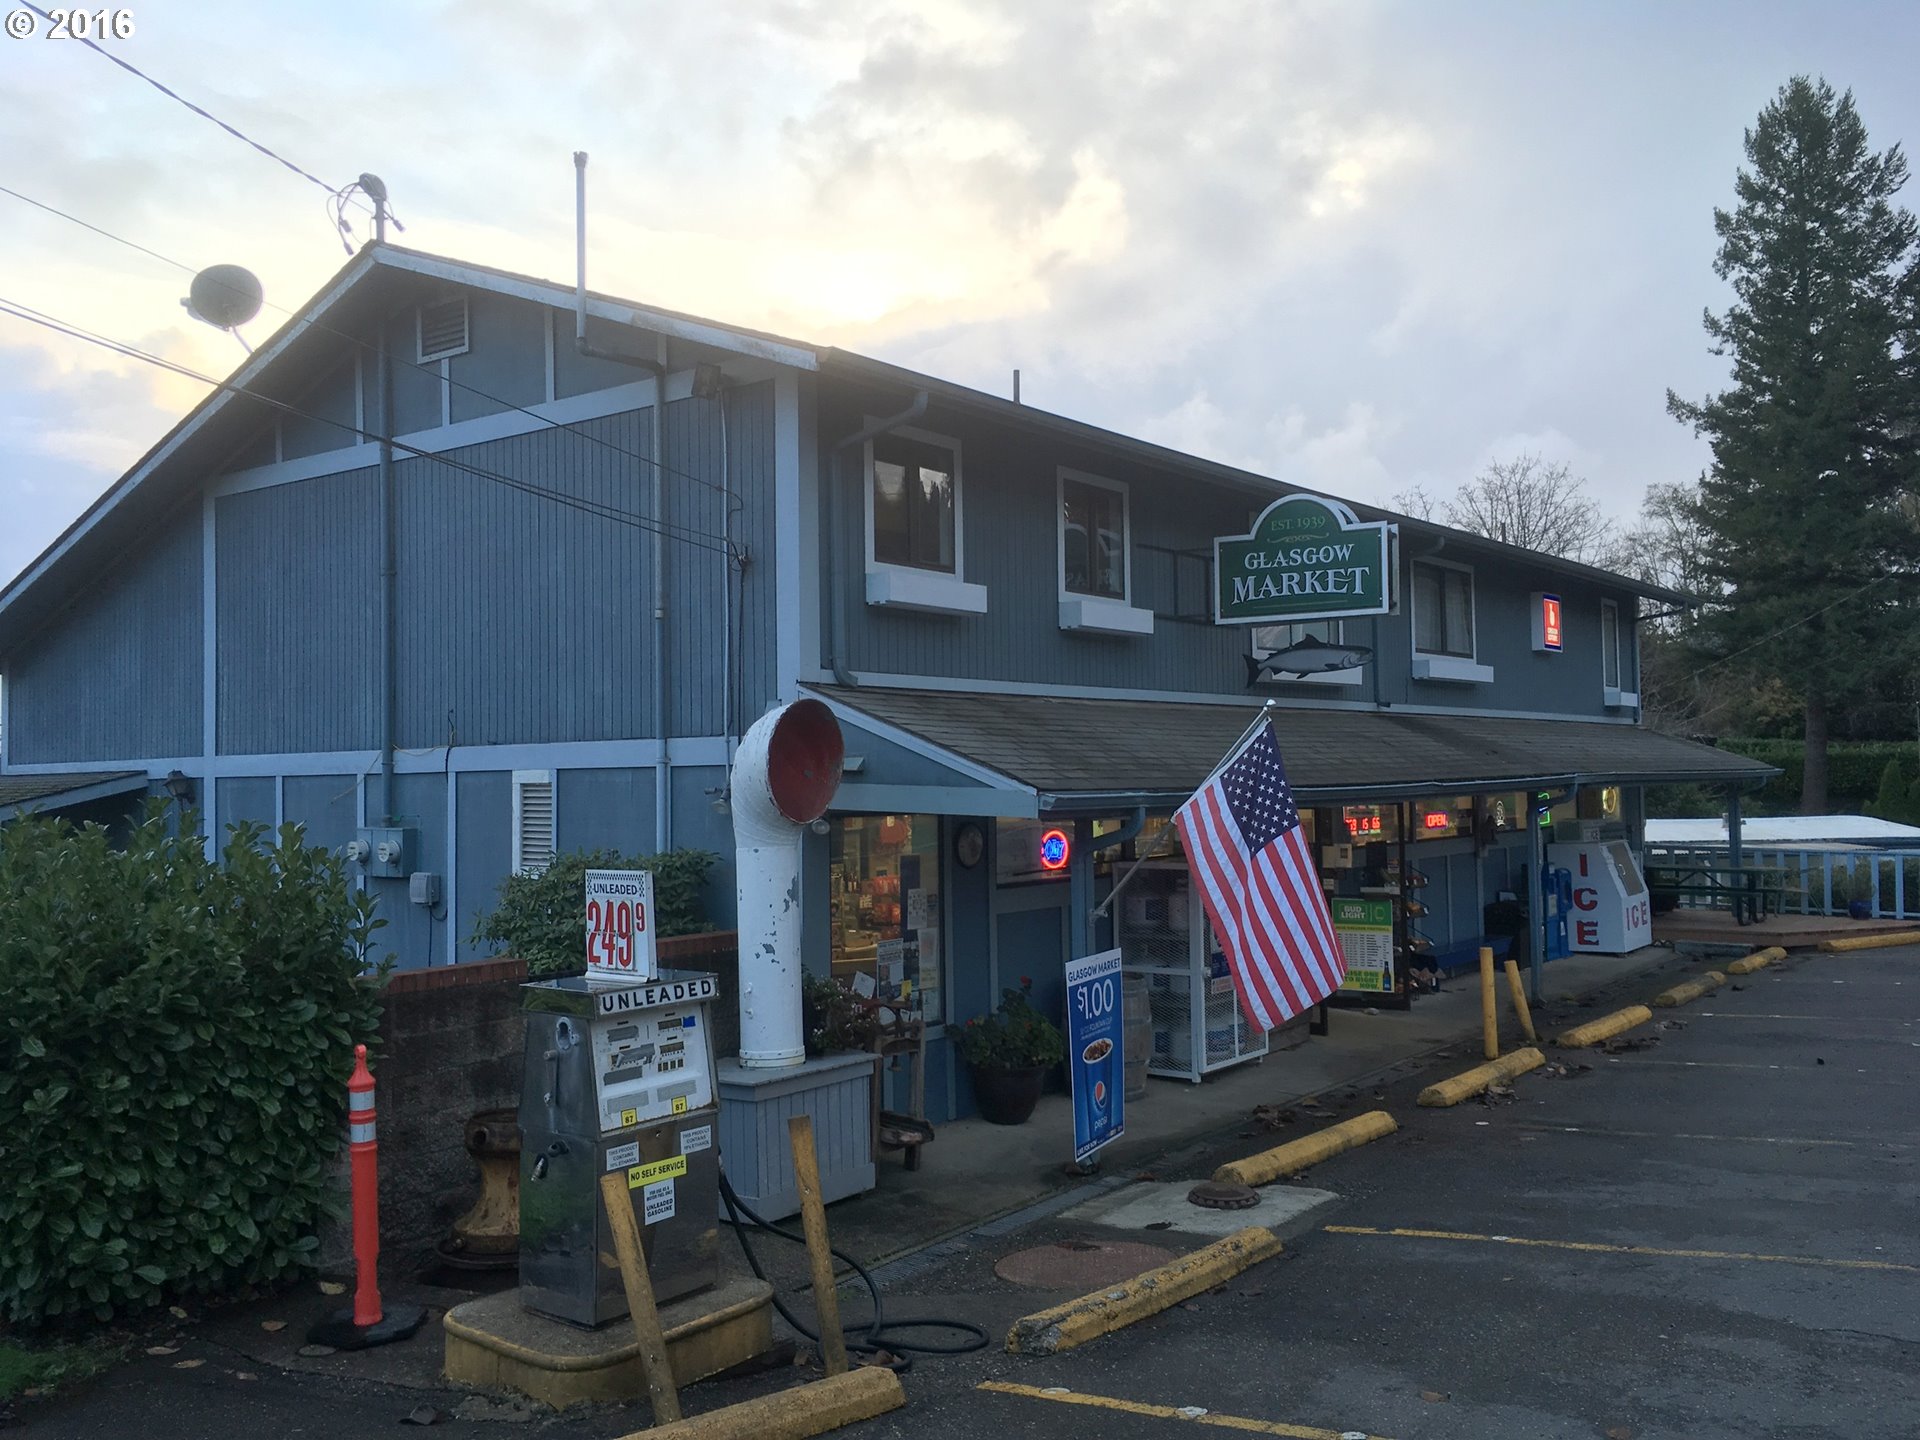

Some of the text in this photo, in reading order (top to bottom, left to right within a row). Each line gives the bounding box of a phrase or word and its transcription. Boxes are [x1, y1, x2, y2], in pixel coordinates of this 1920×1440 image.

[1271, 516, 1326, 531] EST. 1939
[1244, 544, 1355, 570] GLASGOW
[1231, 567, 1370, 605] MARKET
[1427, 814, 1446, 828] OPEN
[593, 883, 638, 896] UNLEADED
[1573, 853, 1599, 946] ICE
[1625, 901, 1648, 931] ICE
[1068, 958, 1120, 982] GLASGOW MARKET
[602, 980, 711, 1012] UNLEADED
[1077, 978, 1114, 1020] $1.00
[675, 1103, 684, 1111] 87
[624, 1115, 633, 1124] 87
[613, 1152, 634, 1161] CONTAINS
[618, 1144, 638, 1154] PRODUCT
[630, 1160, 685, 1181] NO SELF SERVICE
[646, 1198, 673, 1212] UNLEADED
[647, 1205, 673, 1218] GASOLINE
